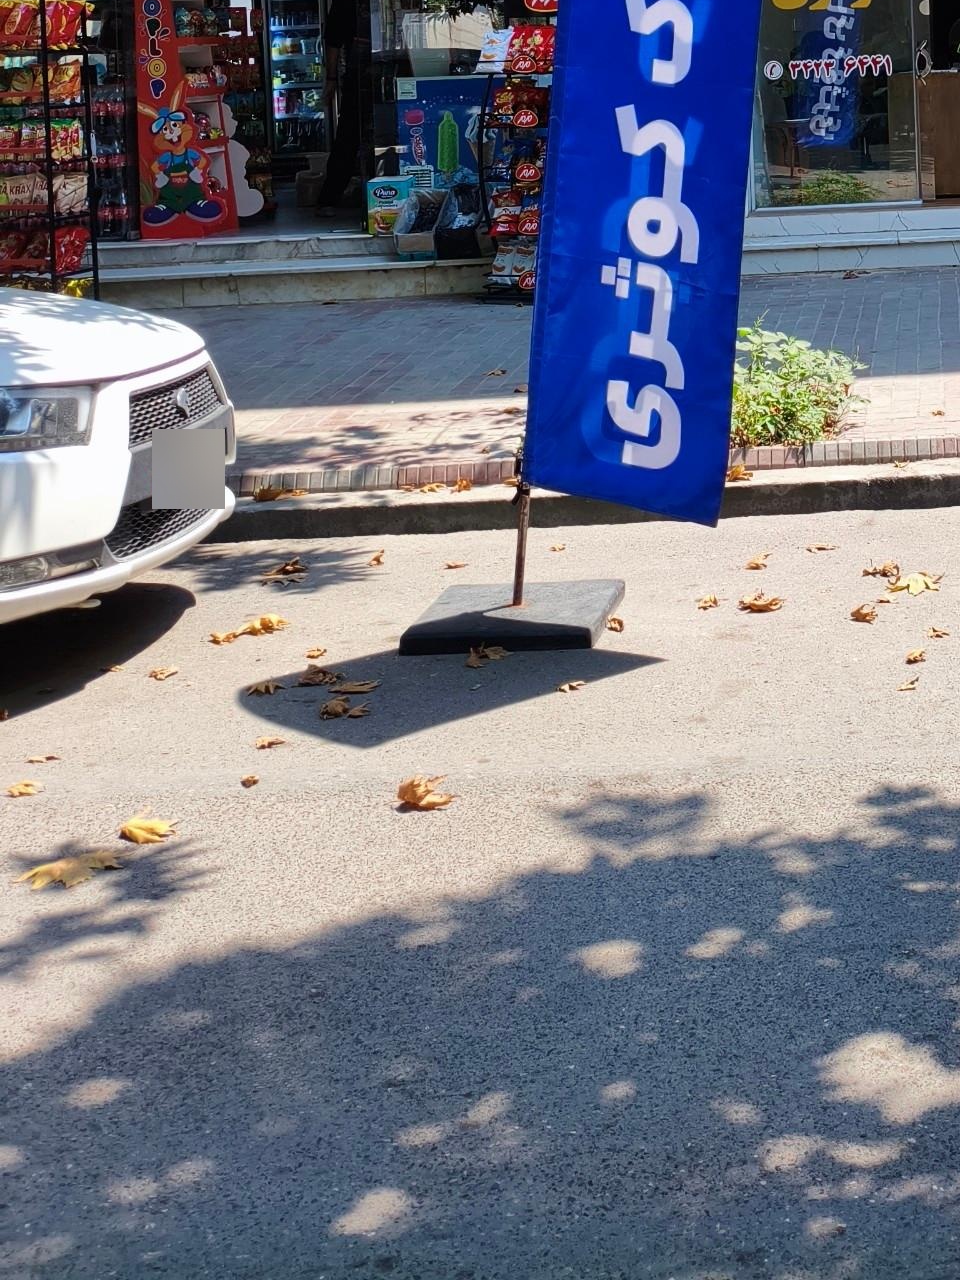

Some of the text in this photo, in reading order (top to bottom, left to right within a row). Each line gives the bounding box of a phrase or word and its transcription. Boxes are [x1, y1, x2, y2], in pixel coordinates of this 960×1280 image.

[788, 54, 893, 80] ۳۴۲۳ ۶۴۴۱
[9, 183, 32, 196] KRAX
[600, 103, 702, 470] کوثری
